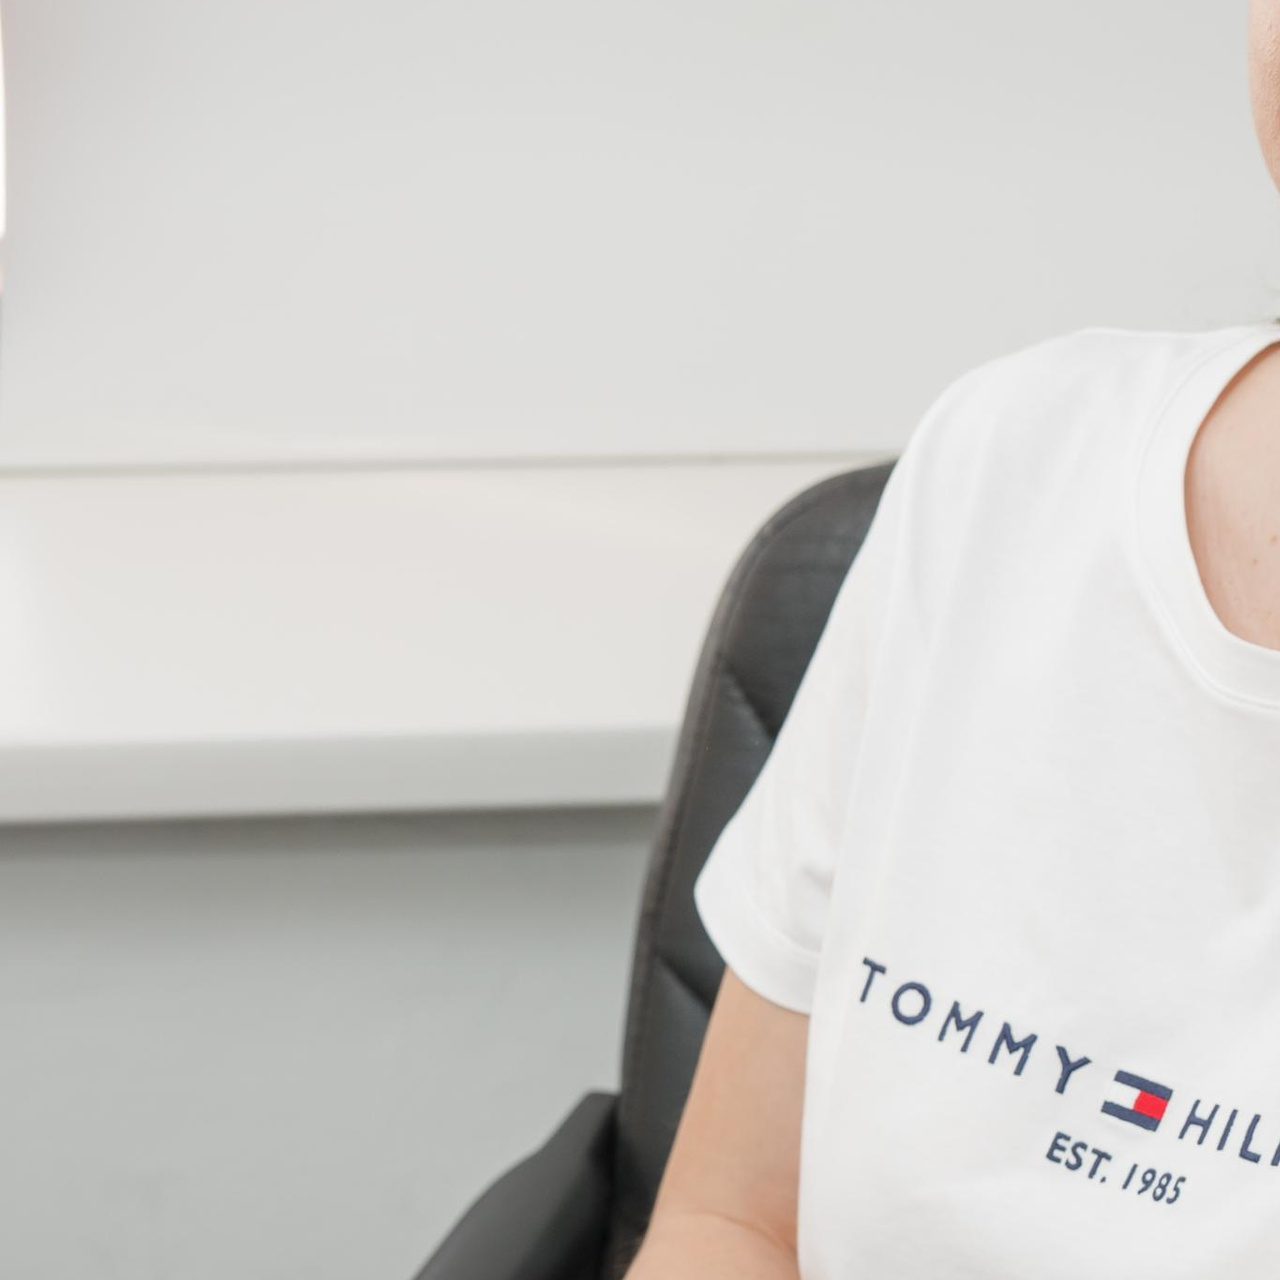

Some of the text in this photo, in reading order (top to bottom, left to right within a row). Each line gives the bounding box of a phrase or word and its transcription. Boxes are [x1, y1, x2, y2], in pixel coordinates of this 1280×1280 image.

[860, 957, 1092, 1094] TOMMY
[1046, 1132, 1186, 1204] EST. 1985
